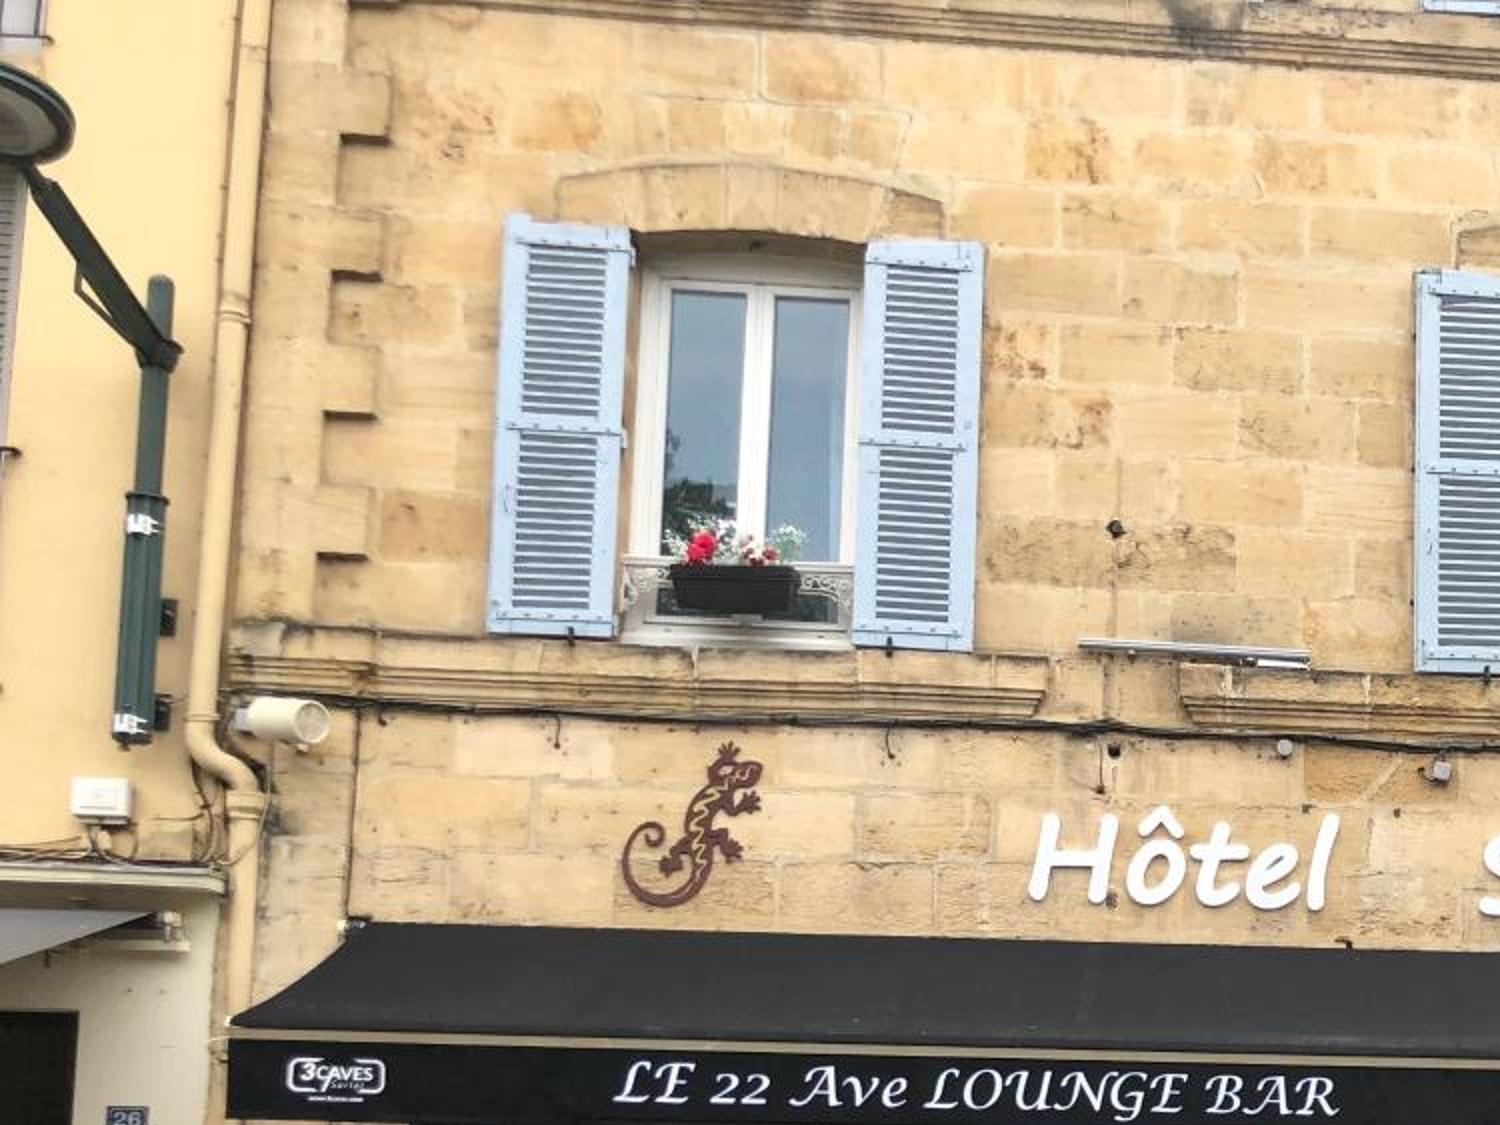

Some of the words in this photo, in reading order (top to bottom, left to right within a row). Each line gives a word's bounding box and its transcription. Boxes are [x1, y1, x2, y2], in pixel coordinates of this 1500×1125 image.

[1027, 805, 1341, 912] Hôtel
[612, 1060, 697, 1104] LE
[709, 1072, 771, 1105] 22
[788, 1064, 908, 1109] Ave
[923, 1066, 1190, 1121] LOUNGE
[1203, 1073, 1341, 1117] BAR
